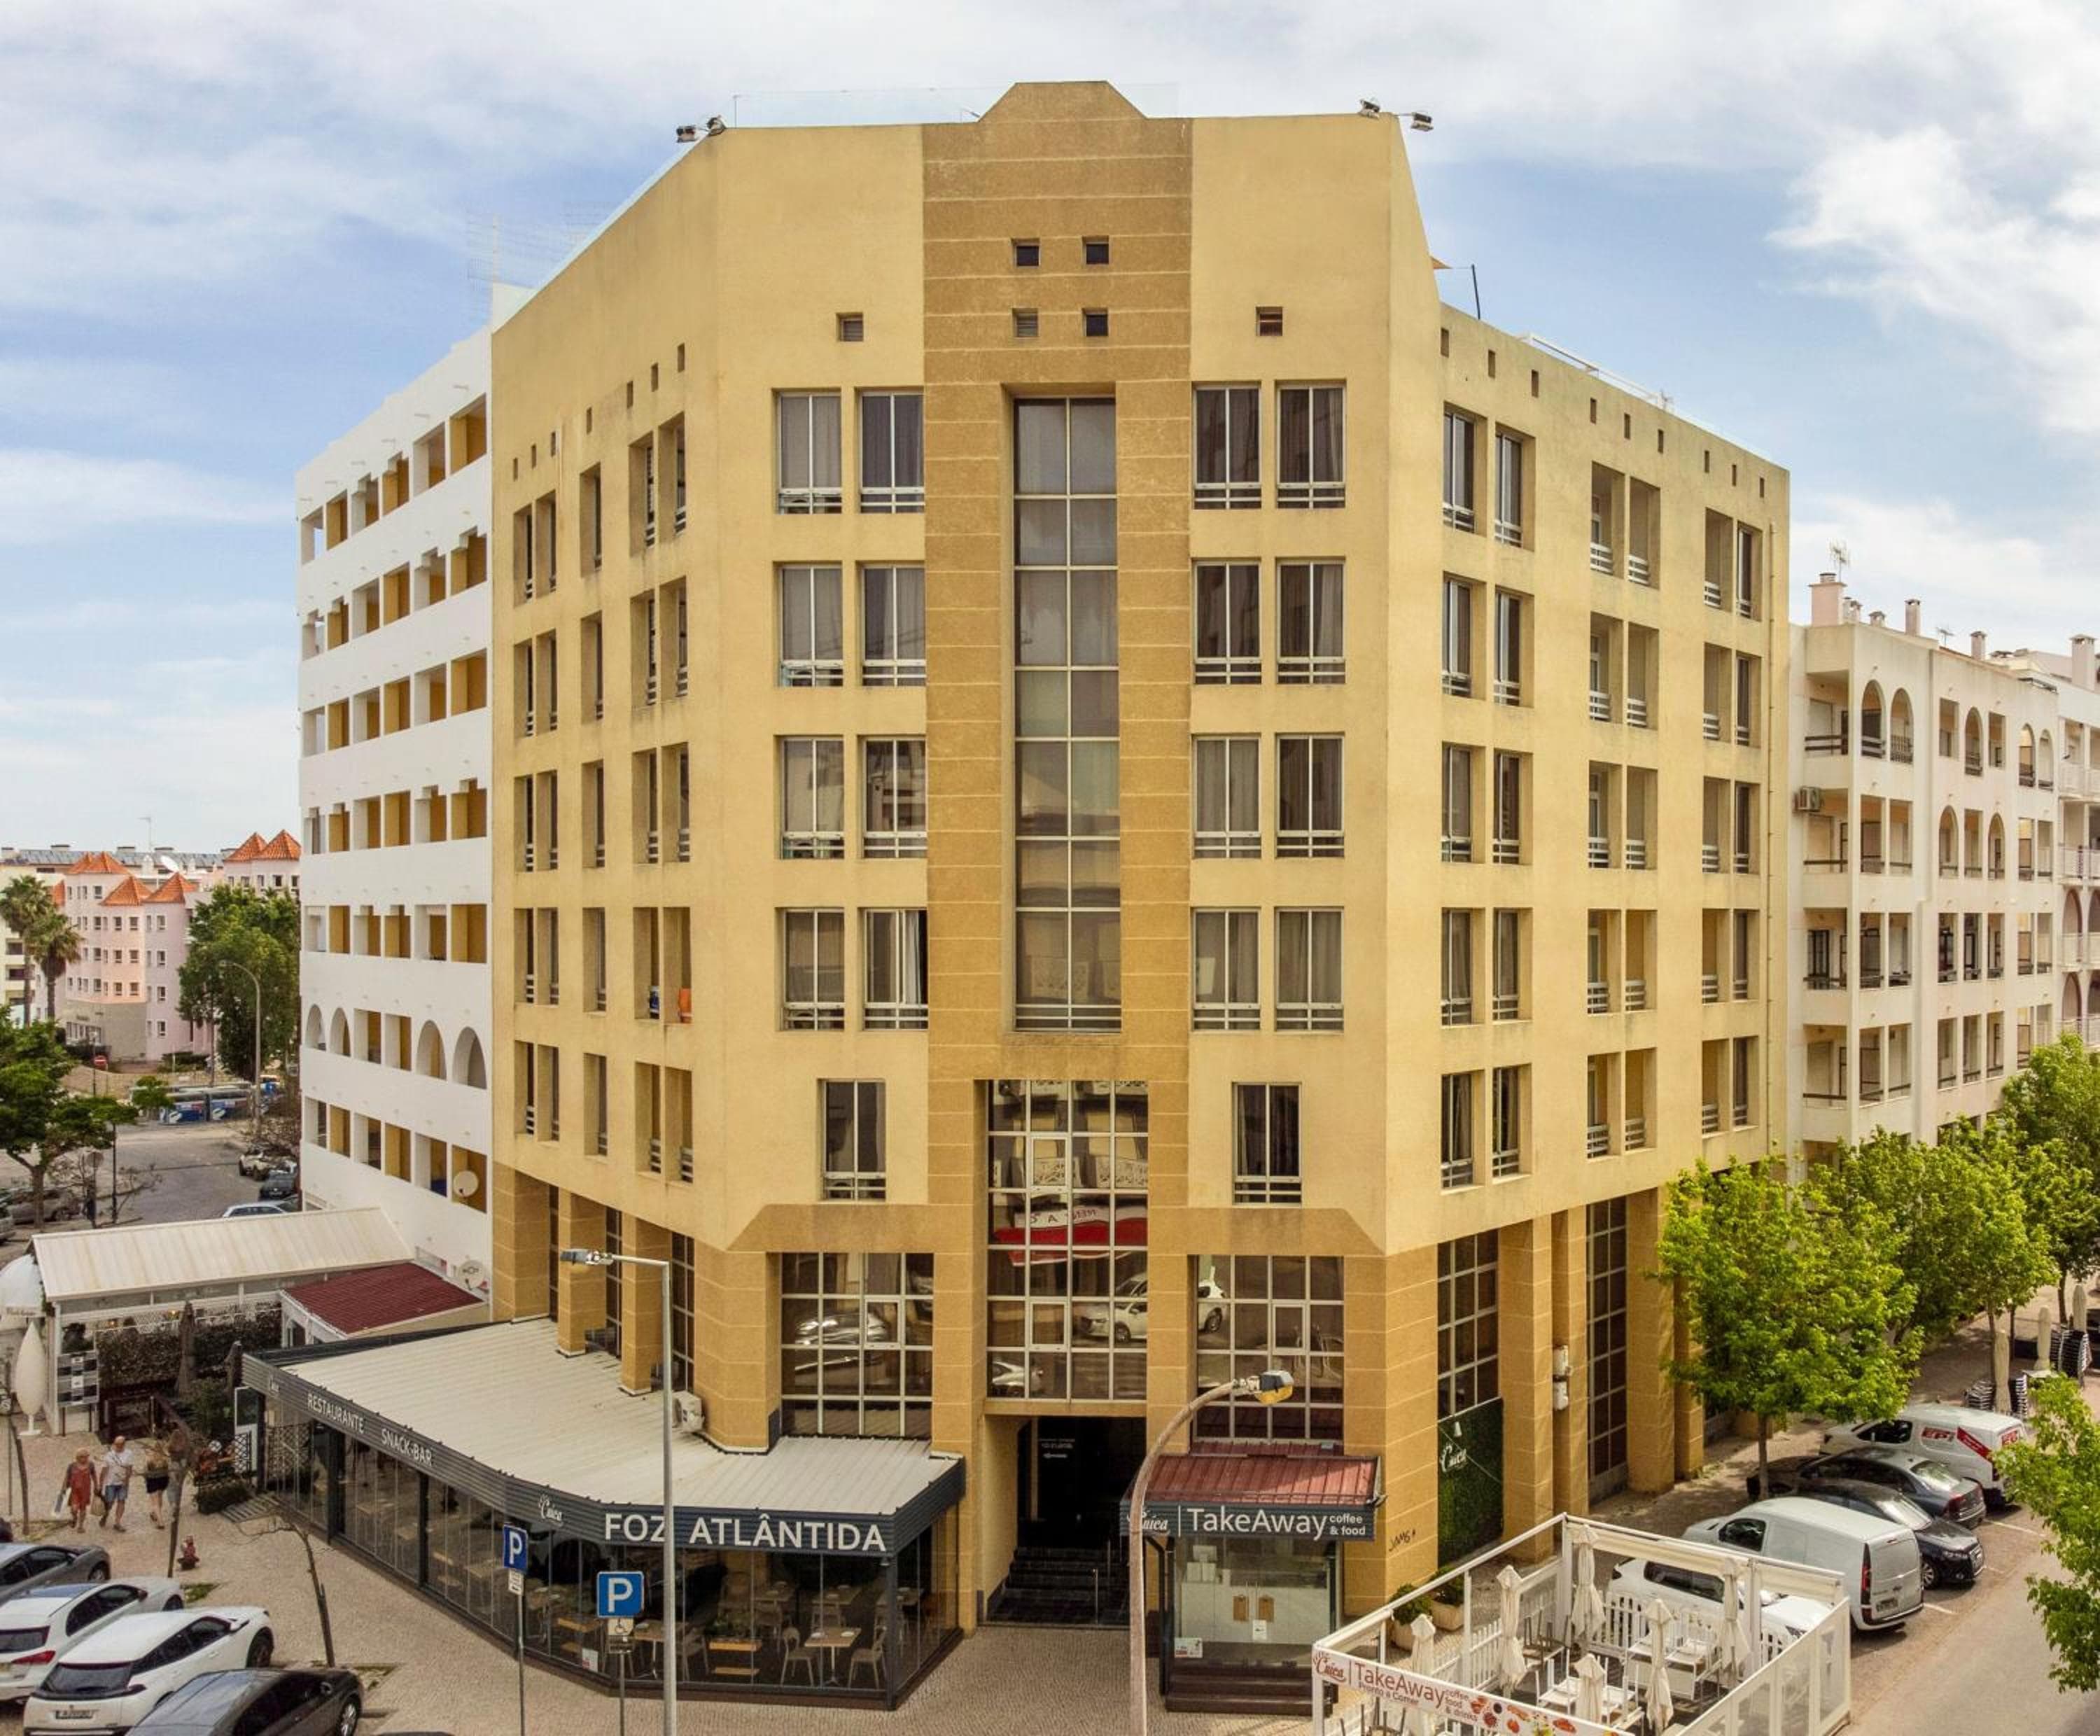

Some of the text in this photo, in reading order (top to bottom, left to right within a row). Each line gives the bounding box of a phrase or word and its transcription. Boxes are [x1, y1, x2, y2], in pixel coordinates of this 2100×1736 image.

[307, 1392, 365, 1434] RESTAURANTE
[604, 1512, 887, 1553] FOZ ATLÂNTIDA
[1187, 1505, 1328, 1541] TakeAway
[1330, 1513, 1363, 1525] coffee
[1331, 1525, 1366, 1536] & food
[509, 1530, 523, 1564] P
[608, 1577, 634, 1614] P
[1354, 1662, 1446, 1709] TakeAway
[1445, 1689, 1469, 1702] coffee
[1445, 1696, 1462, 1709] food
